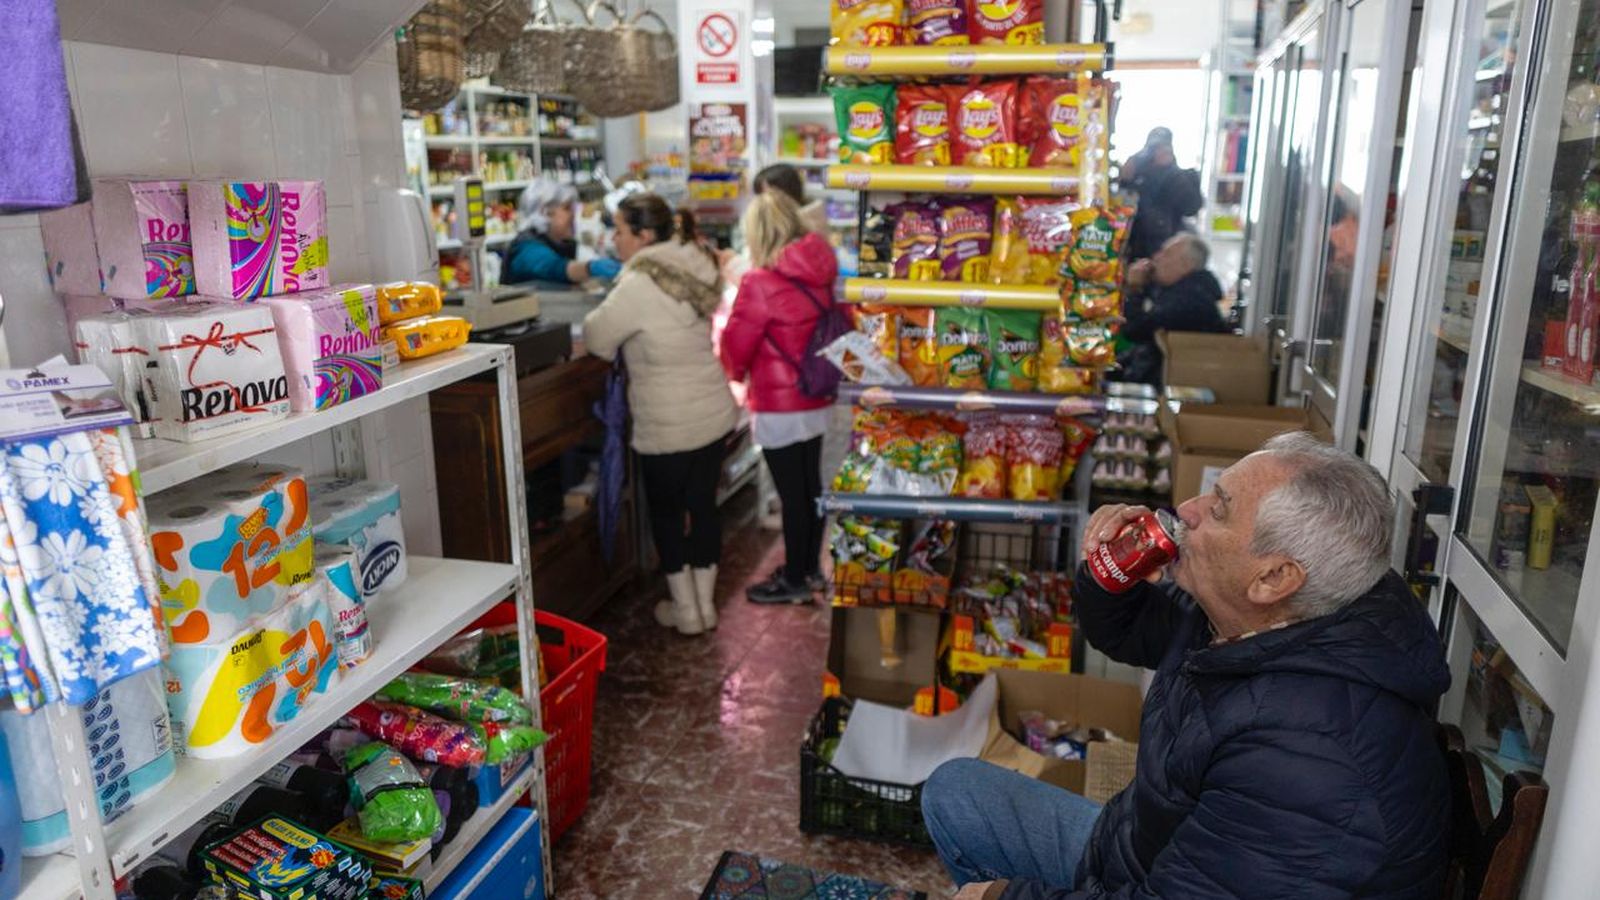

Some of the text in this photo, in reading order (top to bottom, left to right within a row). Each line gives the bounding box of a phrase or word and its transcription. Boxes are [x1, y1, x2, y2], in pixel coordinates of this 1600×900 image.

[281, 192, 301, 293] Renova
[319, 326, 381, 357] Renova
[23, 376, 70, 388] PAMEX
[181, 375, 288, 422] Renova
[367, 549, 399, 590] NICKY
